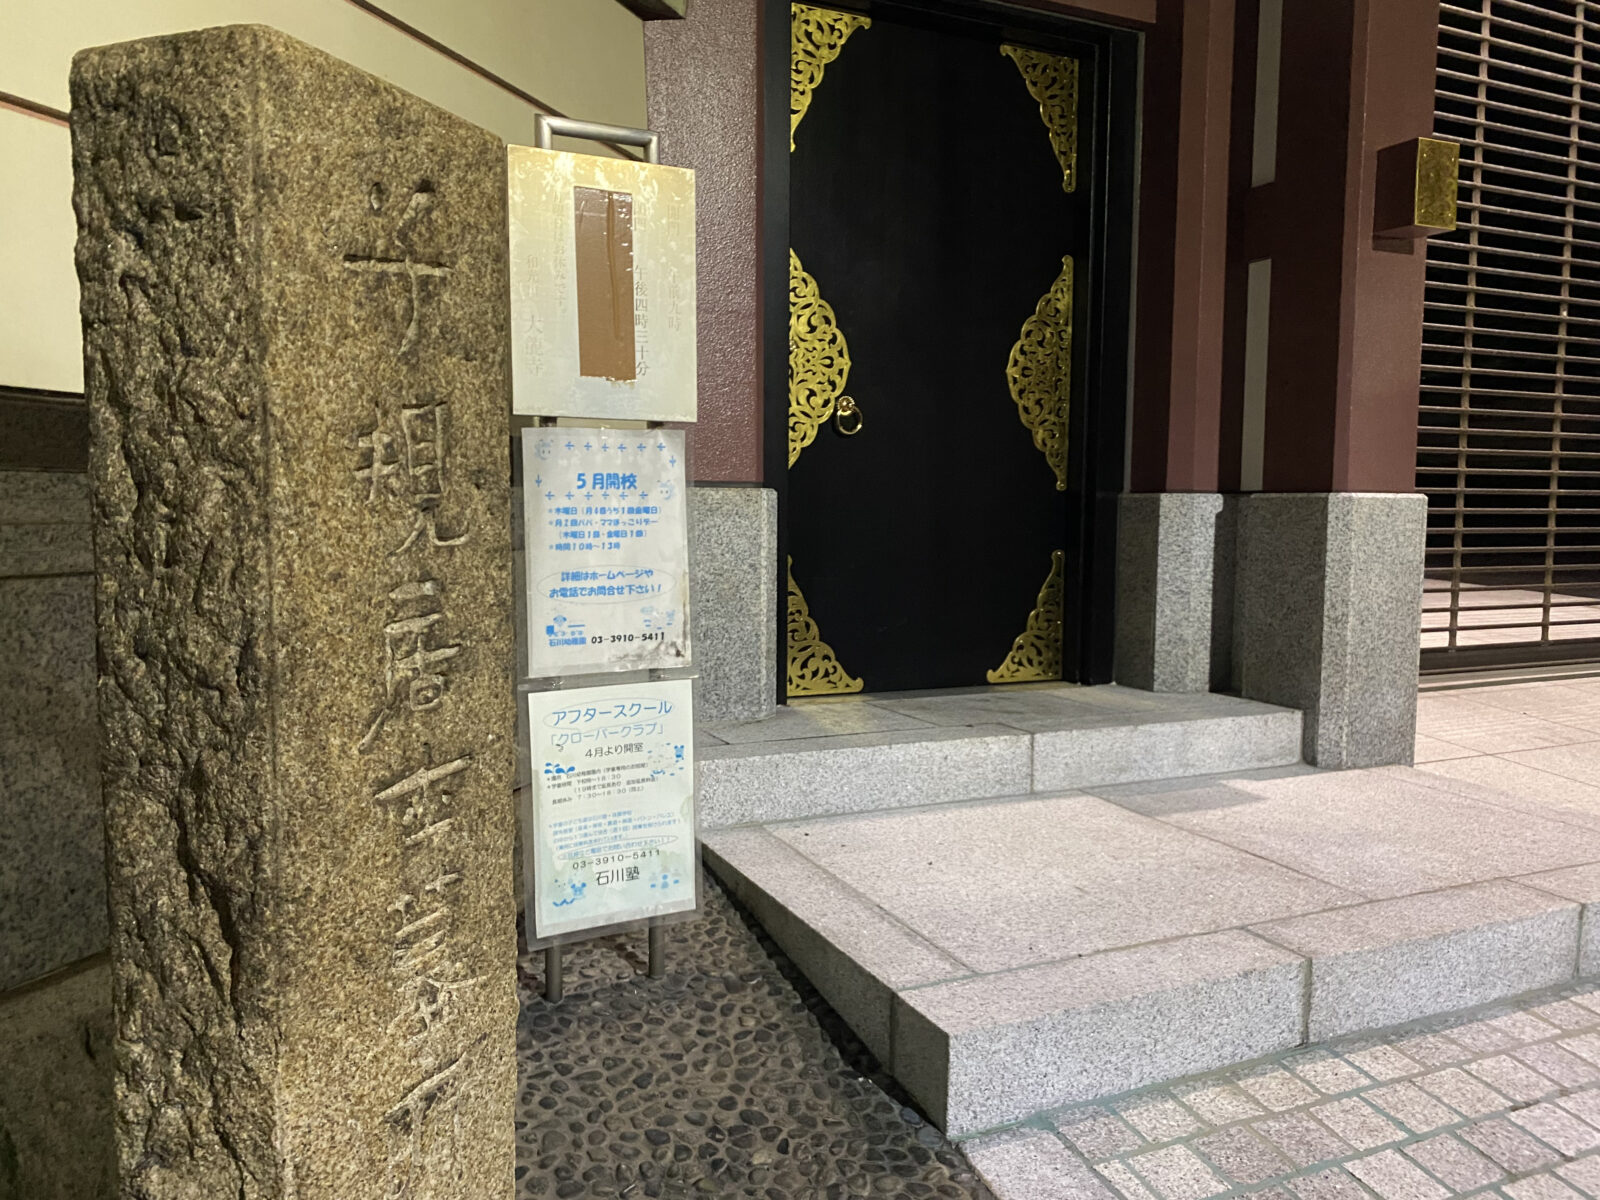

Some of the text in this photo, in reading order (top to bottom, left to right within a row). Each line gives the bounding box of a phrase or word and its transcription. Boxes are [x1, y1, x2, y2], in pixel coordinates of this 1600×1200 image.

[634, 265, 650, 377] 午後四時三十分
[576, 472, 638, 490] 5月開校
[560, 569, 654, 582] 詳細はホームページや
[591, 631, 665, 644] 03-3910-5411
[552, 700, 673, 726] アフタースクール
[584, 742, 644, 759] 4月より開室
[572, 848, 661, 870] 03-3910-5411
[595, 865, 640, 886] 石川塾
